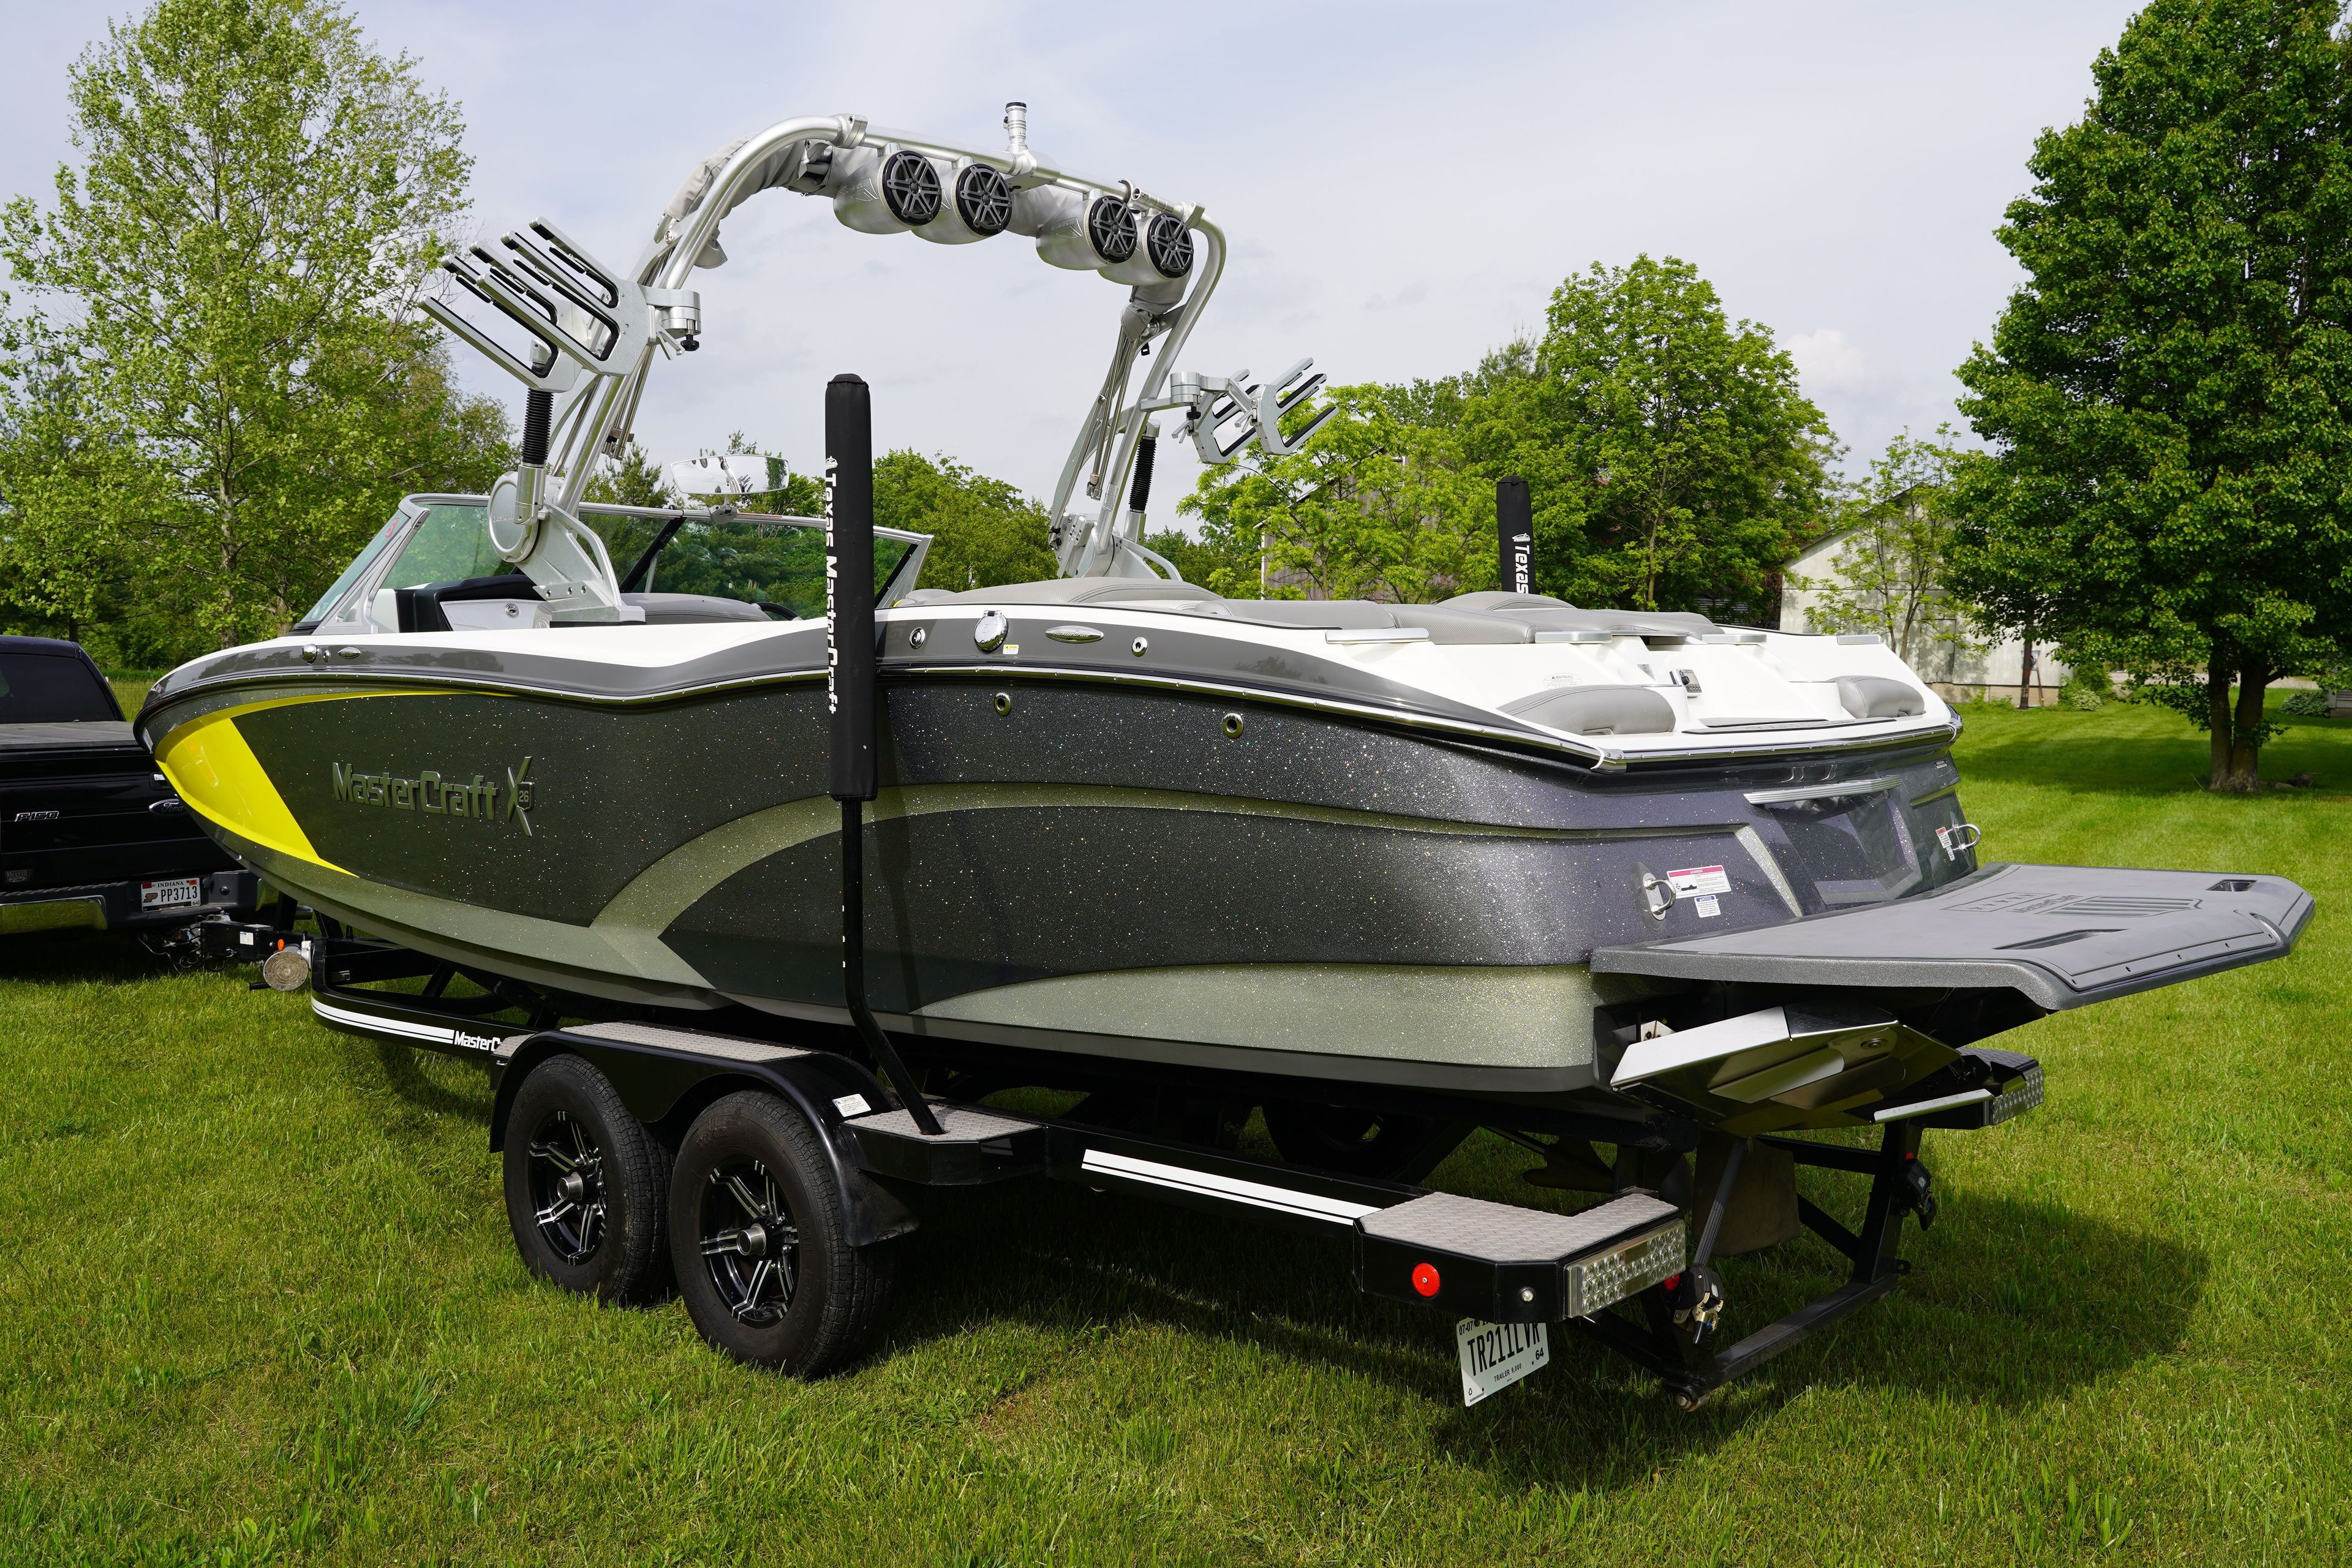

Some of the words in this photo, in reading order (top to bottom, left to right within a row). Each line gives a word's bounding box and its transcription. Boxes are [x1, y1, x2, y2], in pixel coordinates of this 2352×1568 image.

[1514, 545, 1530, 594] Texas
[332, 761, 499, 821] MasterCraft
[518, 790, 530, 802] 26
[160, 886, 197, 902] PP3713
[454, 1030, 502, 1052] MasterC
[1535, 1348, 1544, 1360] 64
[1494, 1369, 1510, 1382] TRAILER
